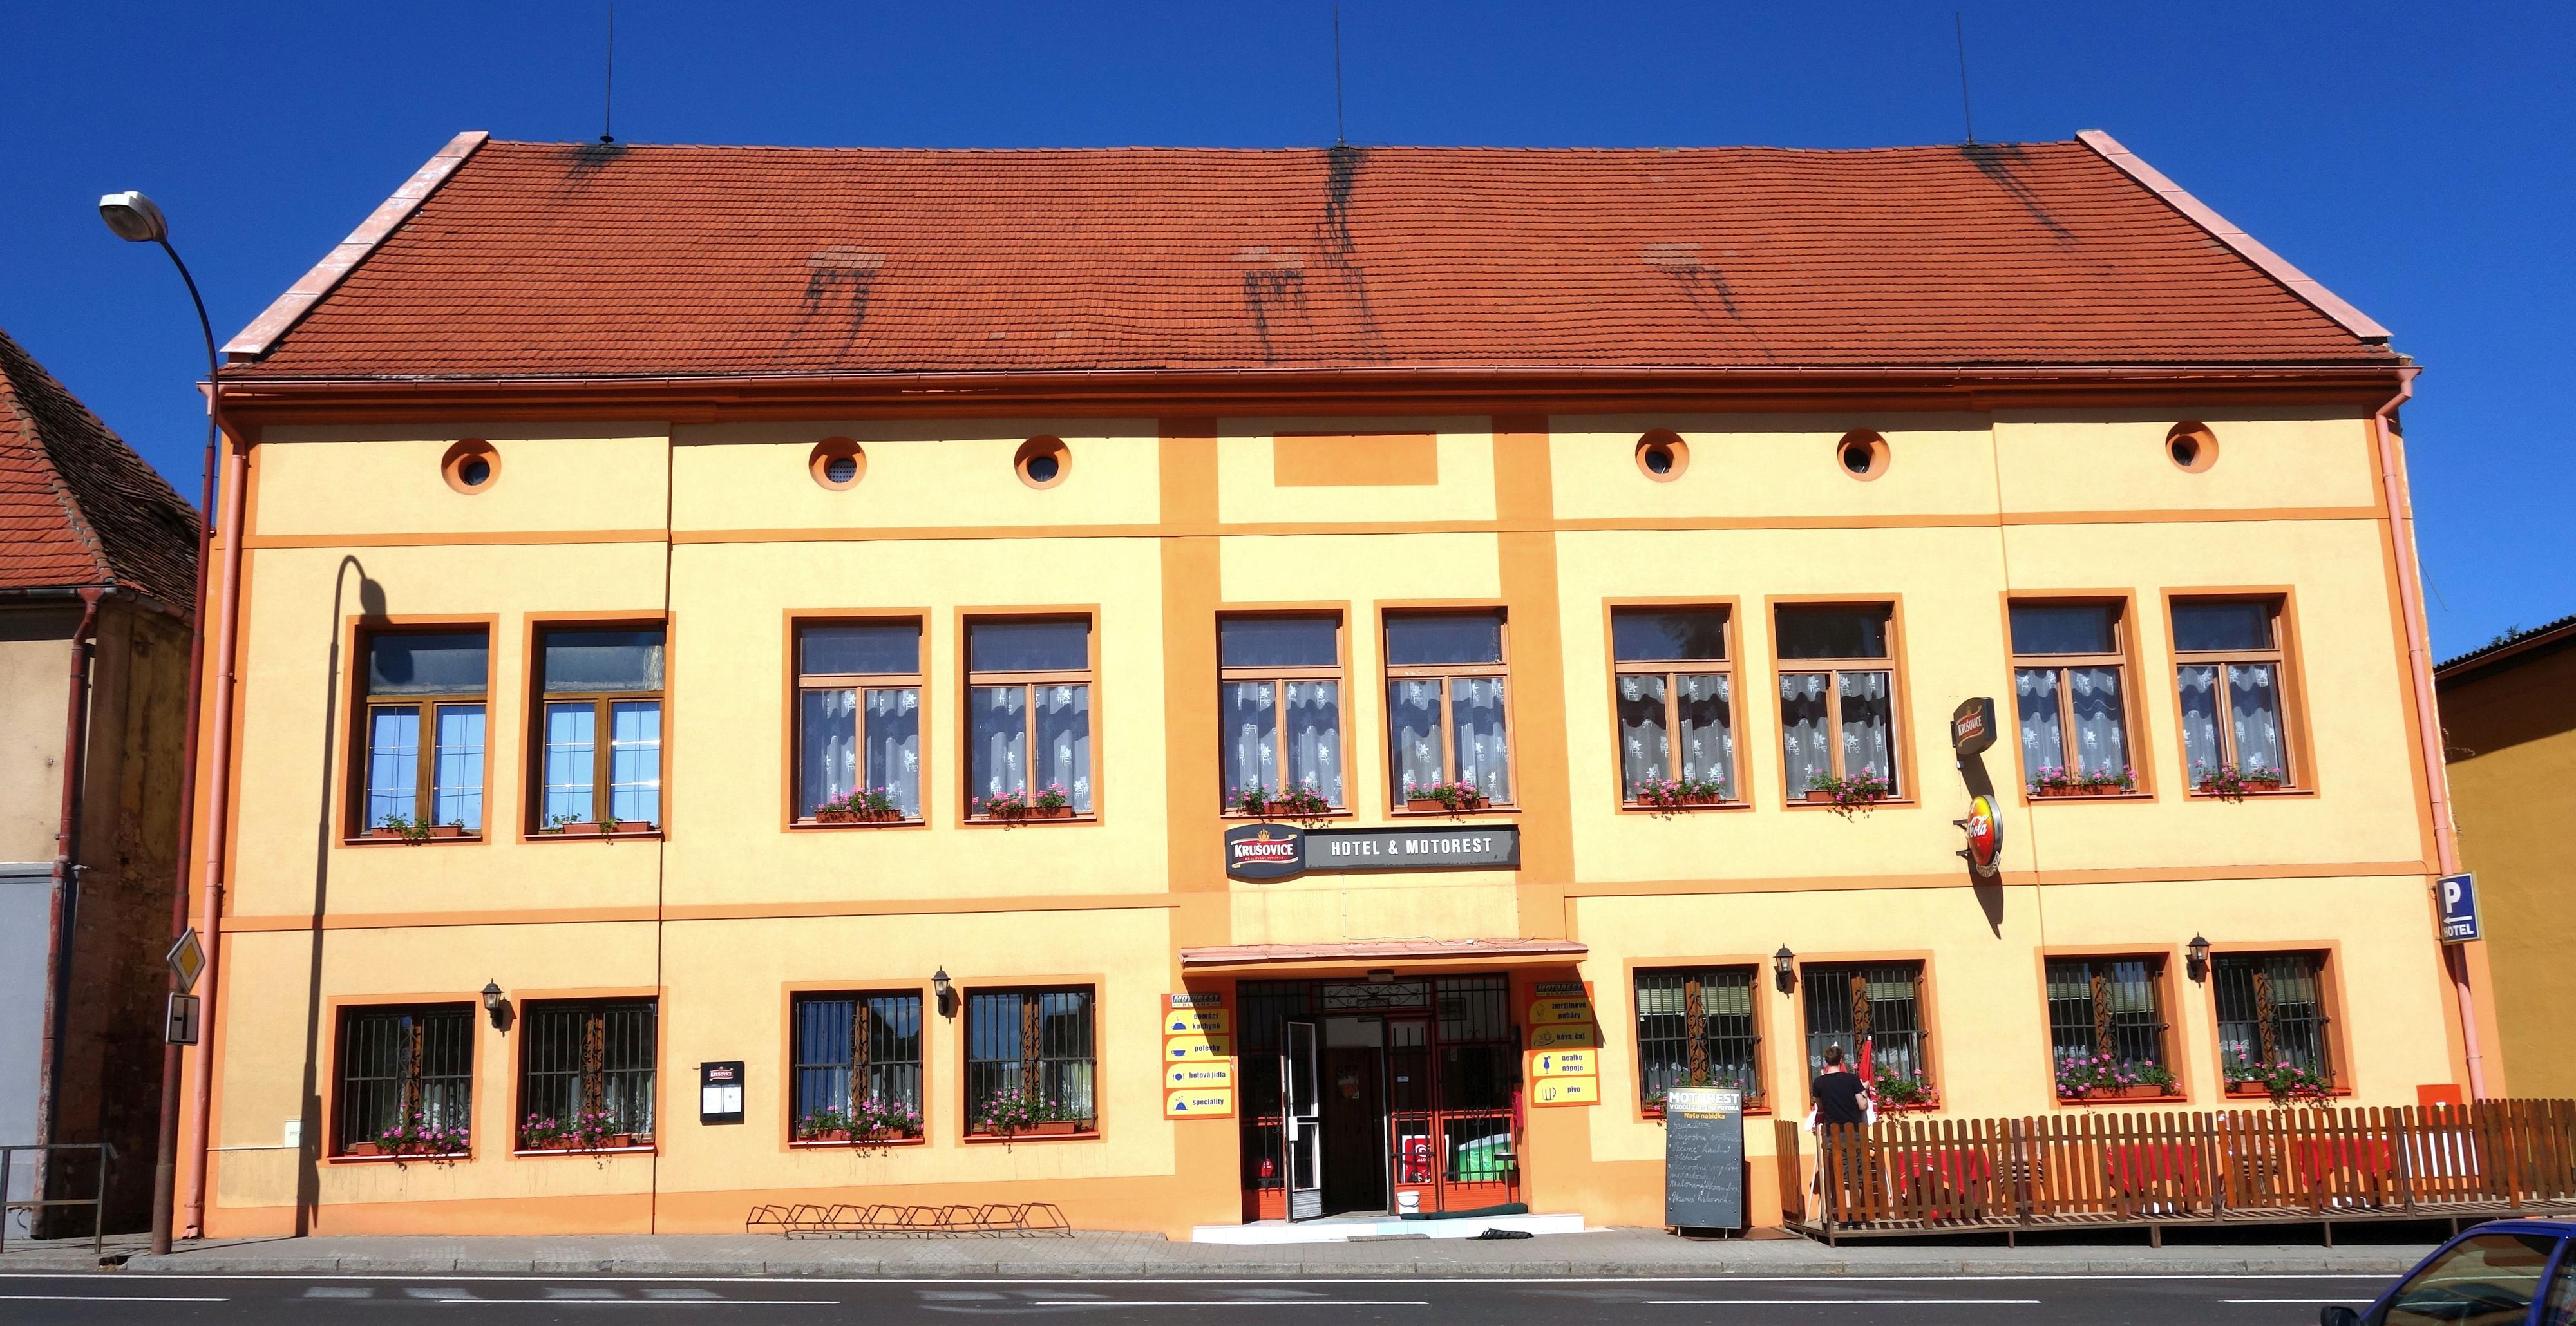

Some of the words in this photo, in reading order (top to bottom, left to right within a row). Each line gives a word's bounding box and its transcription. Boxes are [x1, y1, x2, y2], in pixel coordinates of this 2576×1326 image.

[1235, 842, 1294, 857] KRUŠOVICE
[1331, 840, 1381, 856] HOTEL
[1388, 840, 1399, 855] &
[1406, 838, 1492, 855] MOTOREST
[2443, 882, 2461, 914] P
[2443, 923, 2474, 938] HOTEL
[1192, 1098, 1224, 1106] speciality
[1669, 1092, 1740, 1104] MOTOREST
